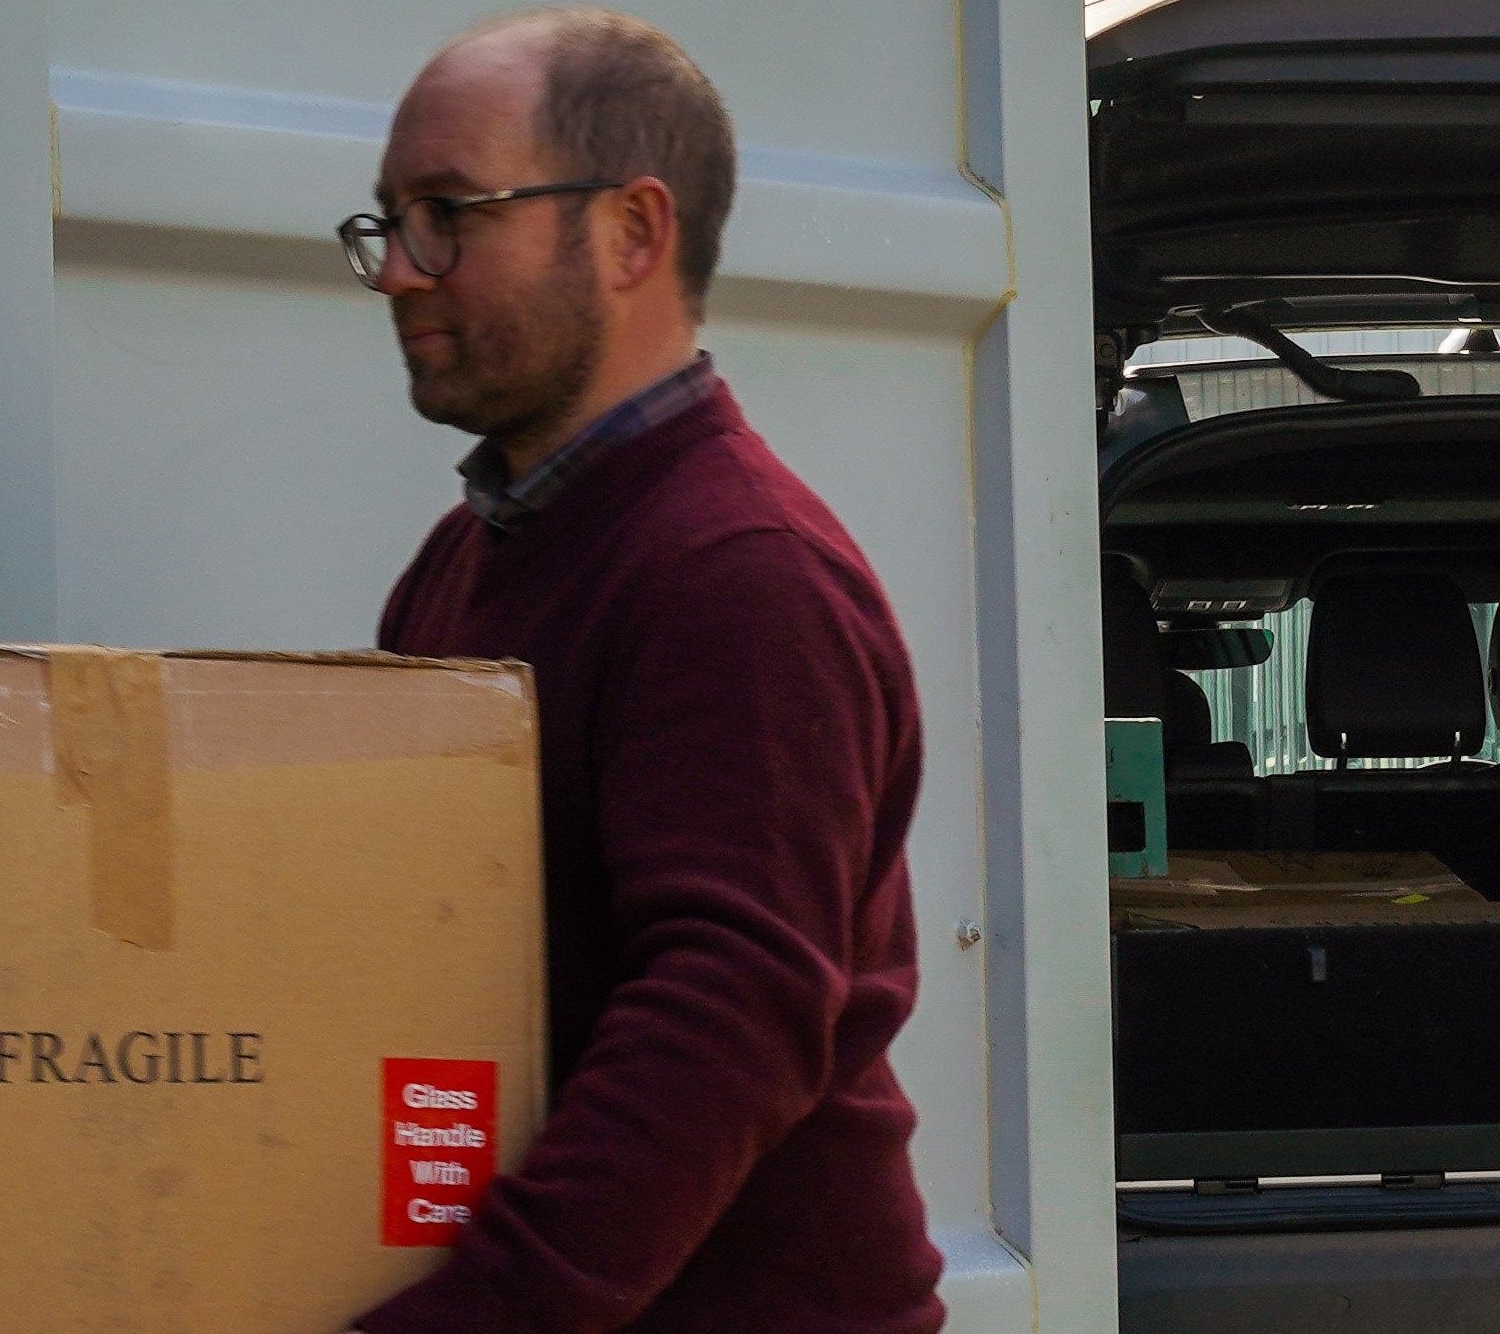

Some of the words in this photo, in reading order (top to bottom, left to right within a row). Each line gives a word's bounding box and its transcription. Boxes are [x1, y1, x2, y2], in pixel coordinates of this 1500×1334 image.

[402, 1082, 479, 1110] Glass
[394, 1120, 487, 1148] Handle
[409, 1160, 471, 1185] With
[407, 1197, 472, 1224] Care
